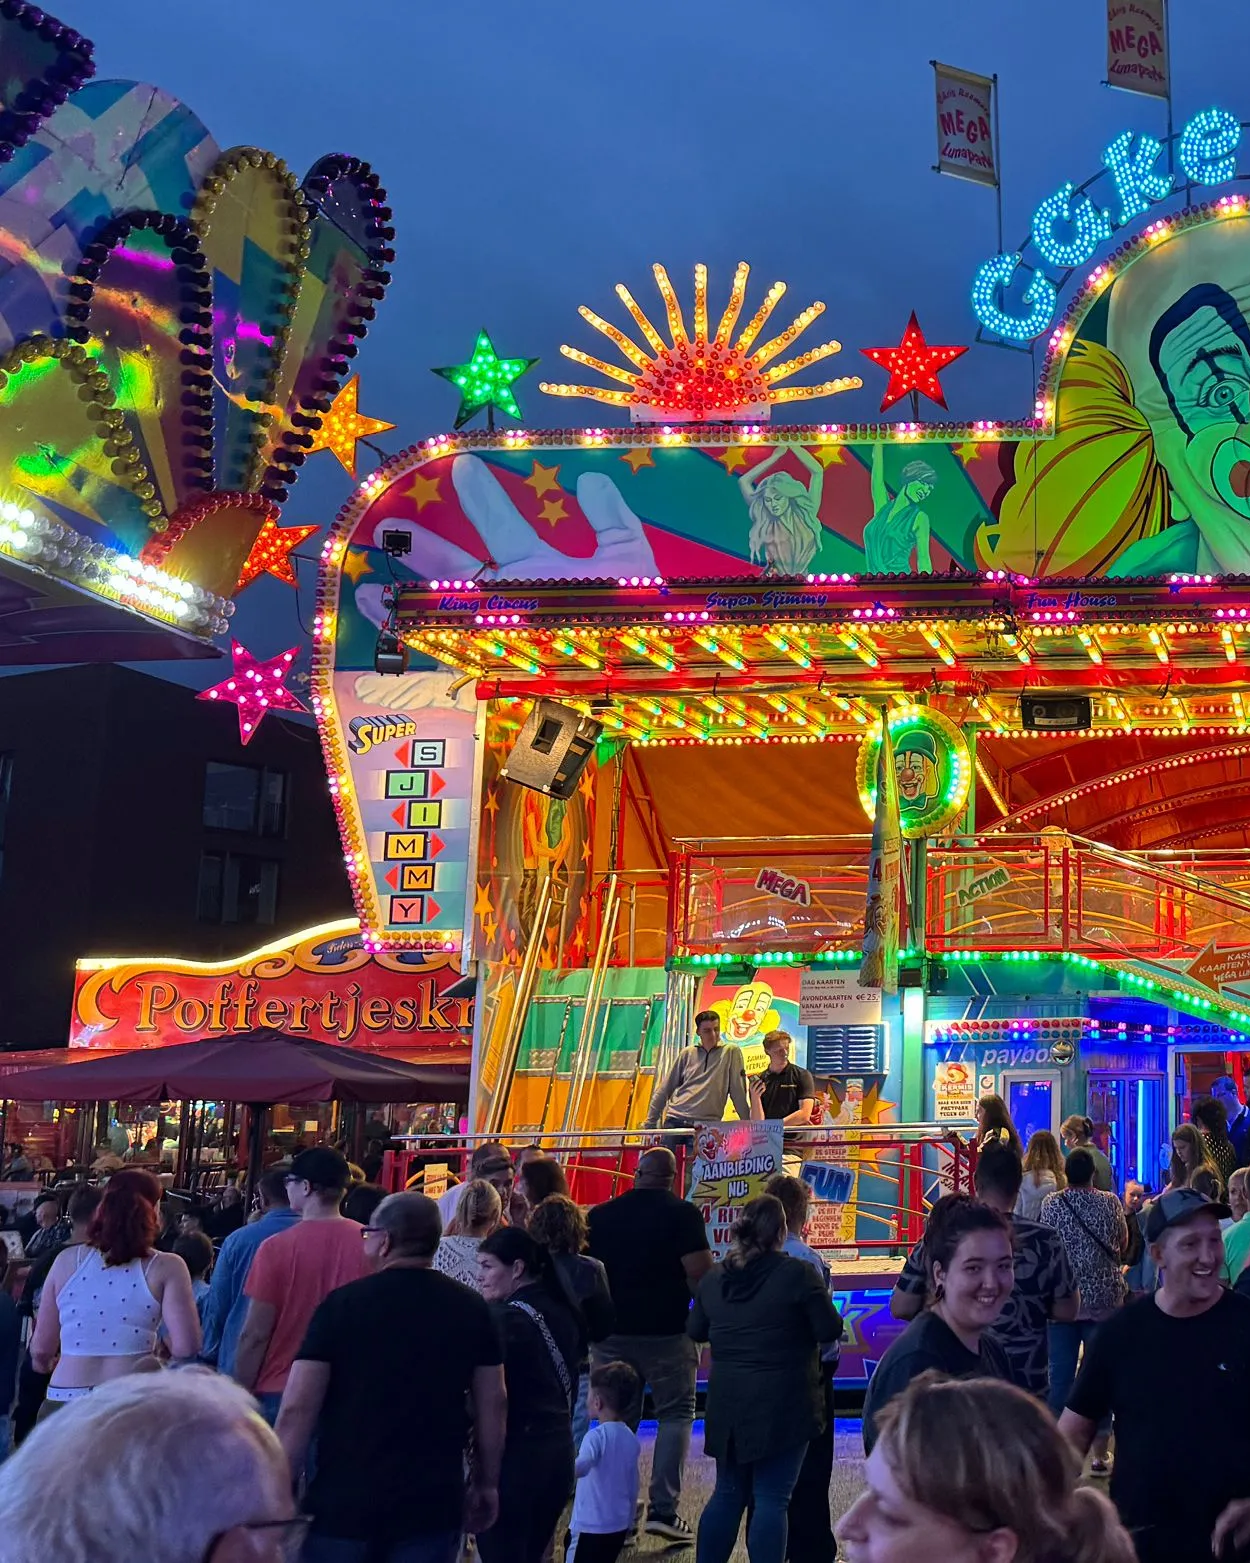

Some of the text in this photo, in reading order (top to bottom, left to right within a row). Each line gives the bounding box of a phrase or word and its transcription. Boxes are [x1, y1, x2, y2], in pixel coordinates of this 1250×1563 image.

[1109, 26, 1163, 58] MEGA
[1109, 59, 1165, 81] Lunapark
[940, 109, 991, 143] MEGA
[942, 142, 993, 168] Lunapark
[438, 594, 539, 613] King Circus
[705, 590, 829, 609] Super Sjimmy
[1025, 592, 1117, 608] Fun House
[349, 714, 416, 755] SUPER
[756, 869, 808, 905] MEGA
[958, 867, 1010, 906] ACTION
[1198, 960, 1244, 973] KAARTEN
[1213, 971, 1237, 982] MEGA
[816, 978, 845, 986] KAARTEN
[801, 994, 852, 1002] AVONDKAARTEN
[981, 1041, 1056, 1067] paybo
[703, 1155, 774, 1180] AANBIEDING
[728, 1180, 749, 1198] NU:
[801, 1163, 852, 1201] FUN
